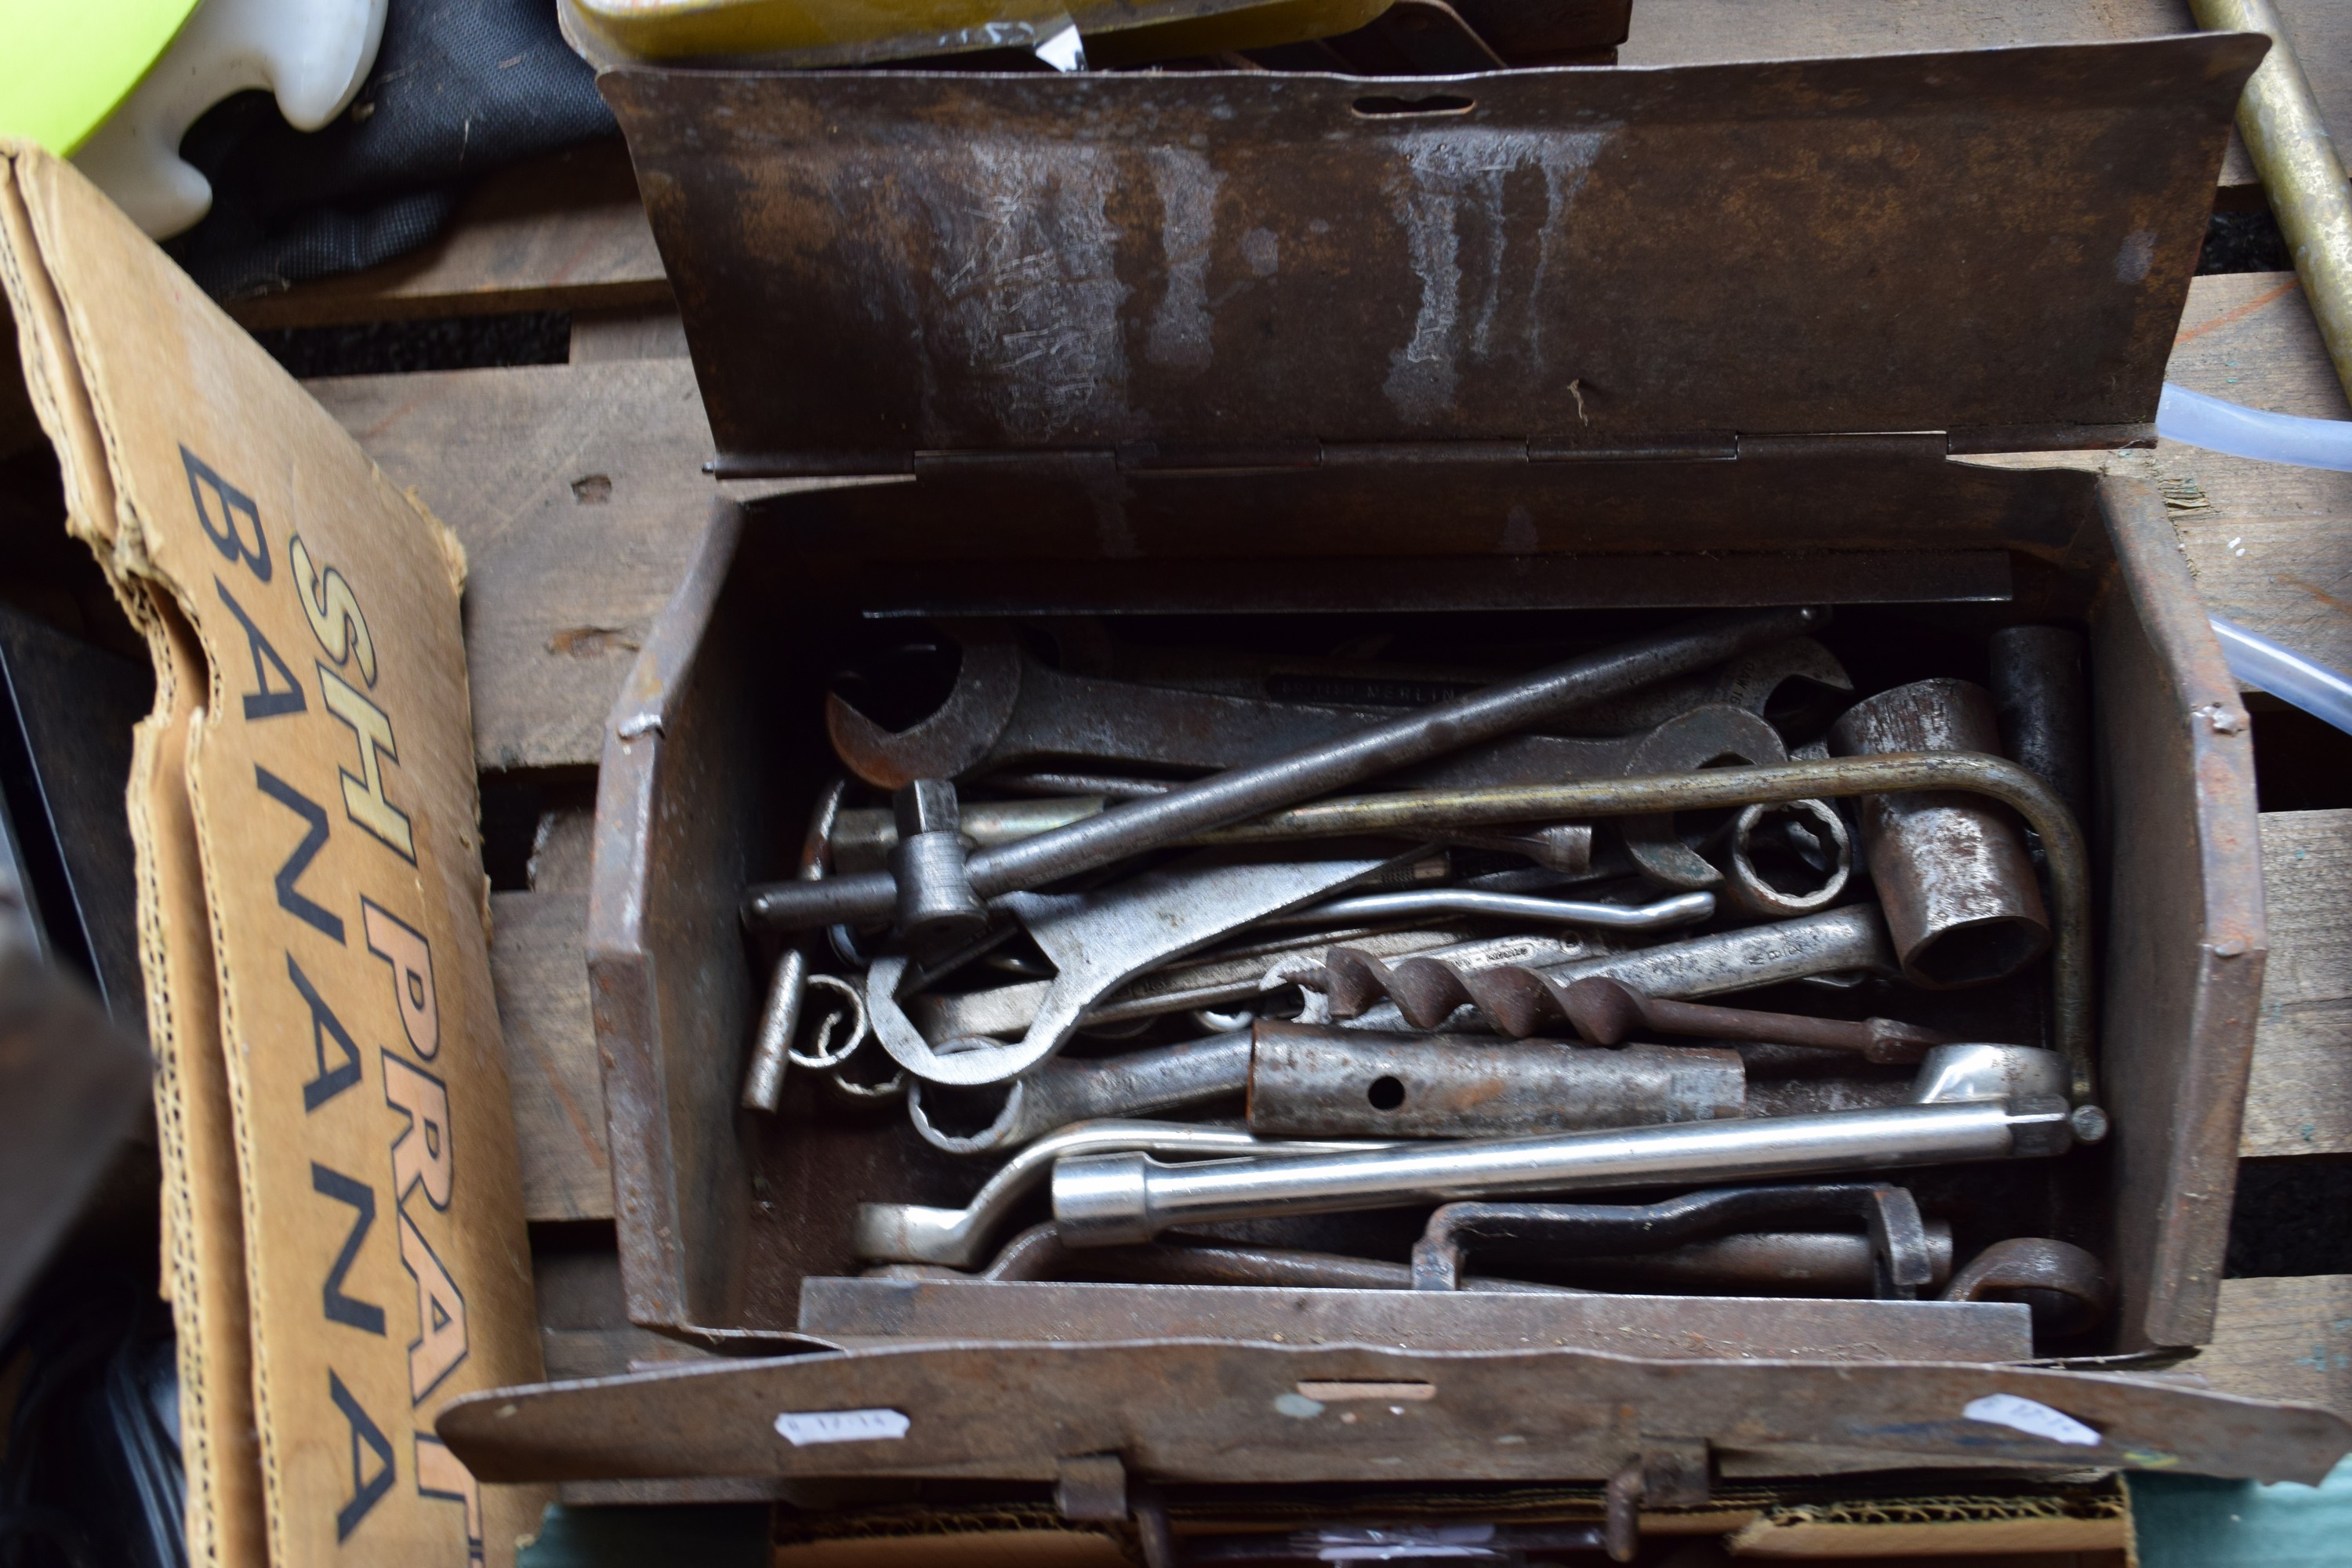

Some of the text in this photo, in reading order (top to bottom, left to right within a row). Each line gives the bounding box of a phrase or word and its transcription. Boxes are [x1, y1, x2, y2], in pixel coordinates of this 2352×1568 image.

[178, 441, 397, 1545] BANANA
[289, 531, 485, 1568] SH PRAT
